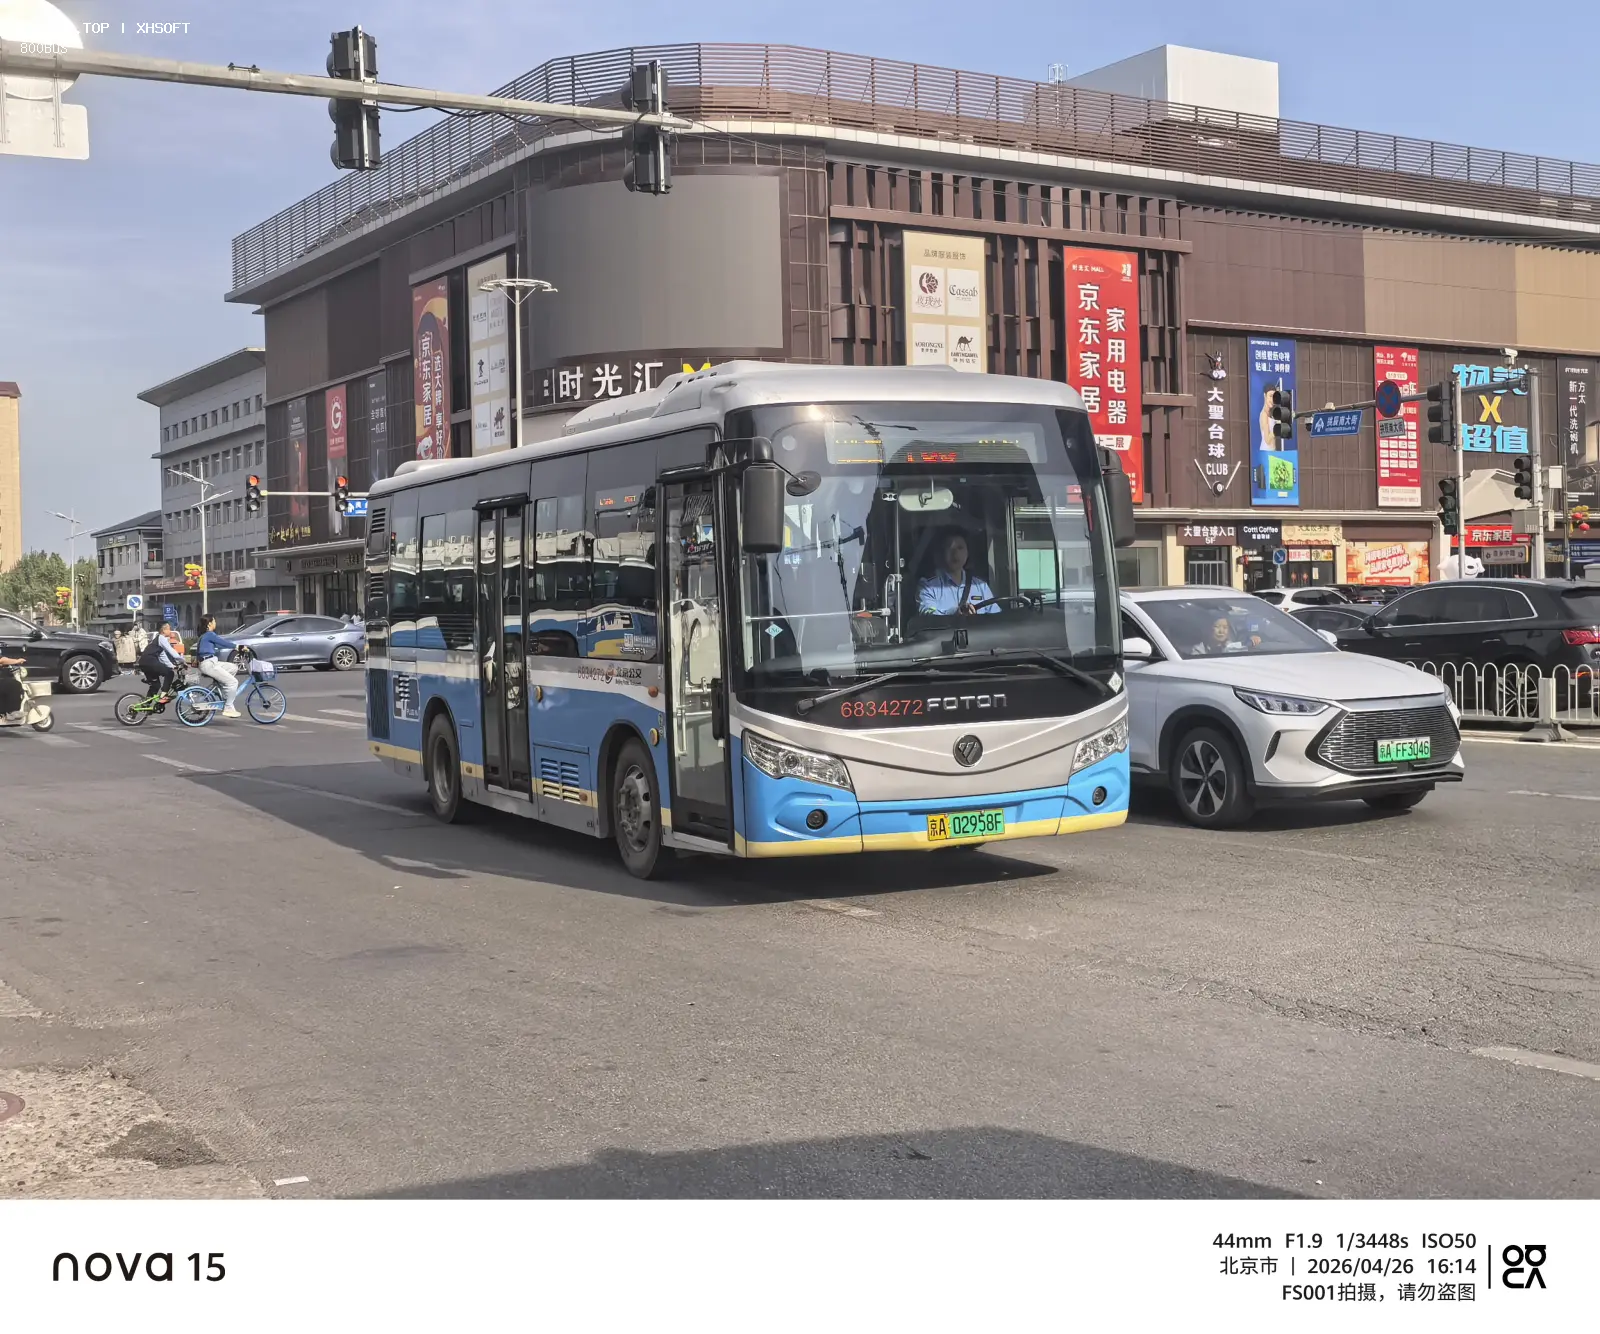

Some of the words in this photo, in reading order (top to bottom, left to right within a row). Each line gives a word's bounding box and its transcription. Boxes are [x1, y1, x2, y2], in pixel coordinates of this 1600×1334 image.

[1077, 283, 1101, 414] 京东家居
[421, 335, 432, 427] 京东家居
[559, 361, 663, 400] 时光汇
[1106, 307, 1127, 424] 家用电器
[1578, 381, 1586, 404] 方太
[1569, 380, 1578, 455] 新一代洗碗机
[1461, 423, 1529, 454] 超值
[1206, 463, 1228, 476] CLUB
[1472, 530, 1512, 541] 京东家居
[840, 699, 923, 718] 6834272
[926, 693, 1008, 712] FOTON
[929, 817, 947, 837] 京A
[952, 812, 1002, 835] 02958F
